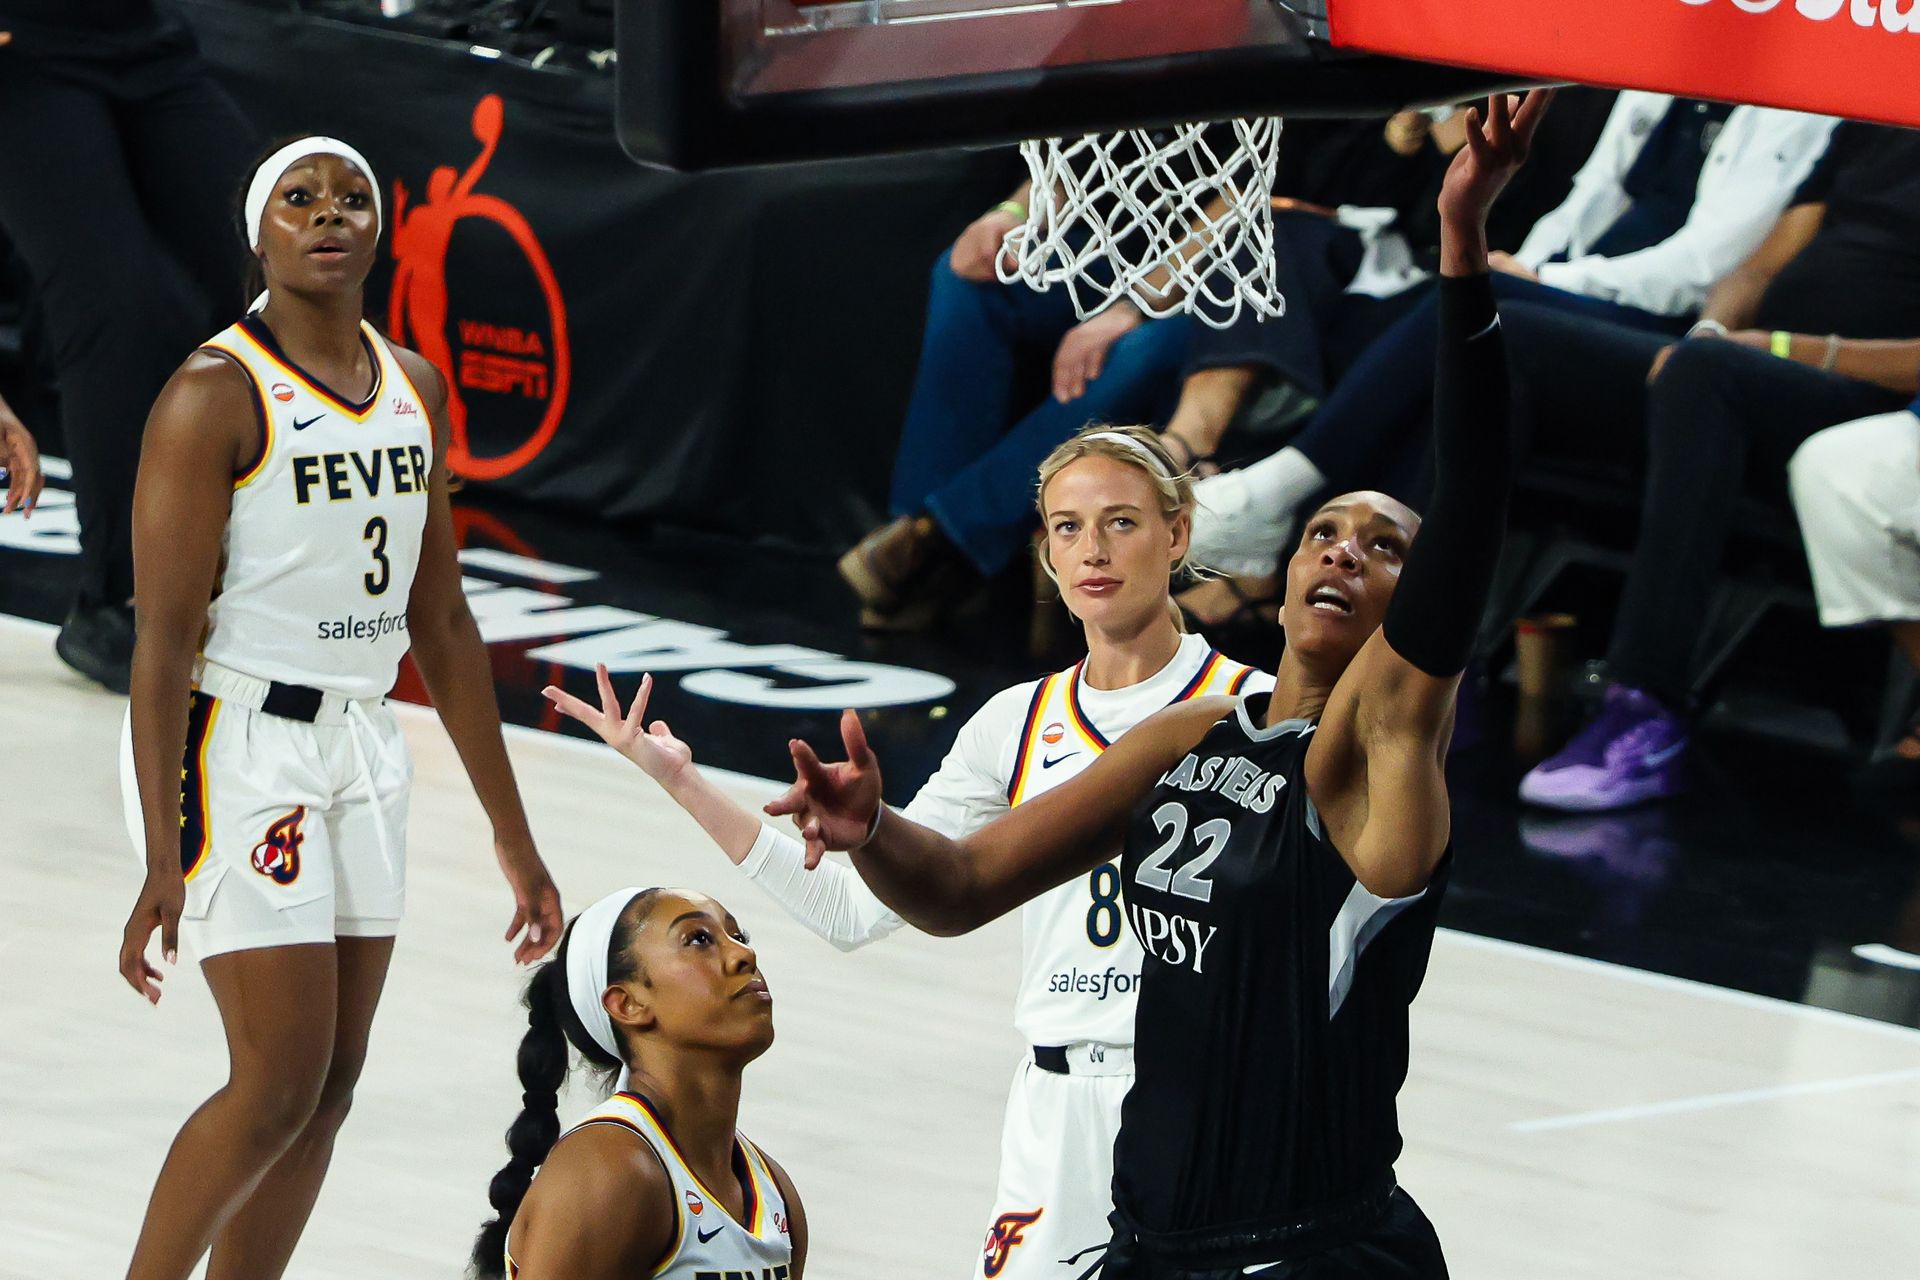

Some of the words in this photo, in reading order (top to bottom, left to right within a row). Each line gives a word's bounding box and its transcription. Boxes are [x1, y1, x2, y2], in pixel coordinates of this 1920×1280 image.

[292, 444, 427, 505] FEVER
[363, 515, 390, 597] 3
[317, 610, 408, 643] salesforc
[1134, 801, 1232, 903] 22
[1086, 862, 1122, 950] 8
[1048, 966, 1142, 1001] salesfor
